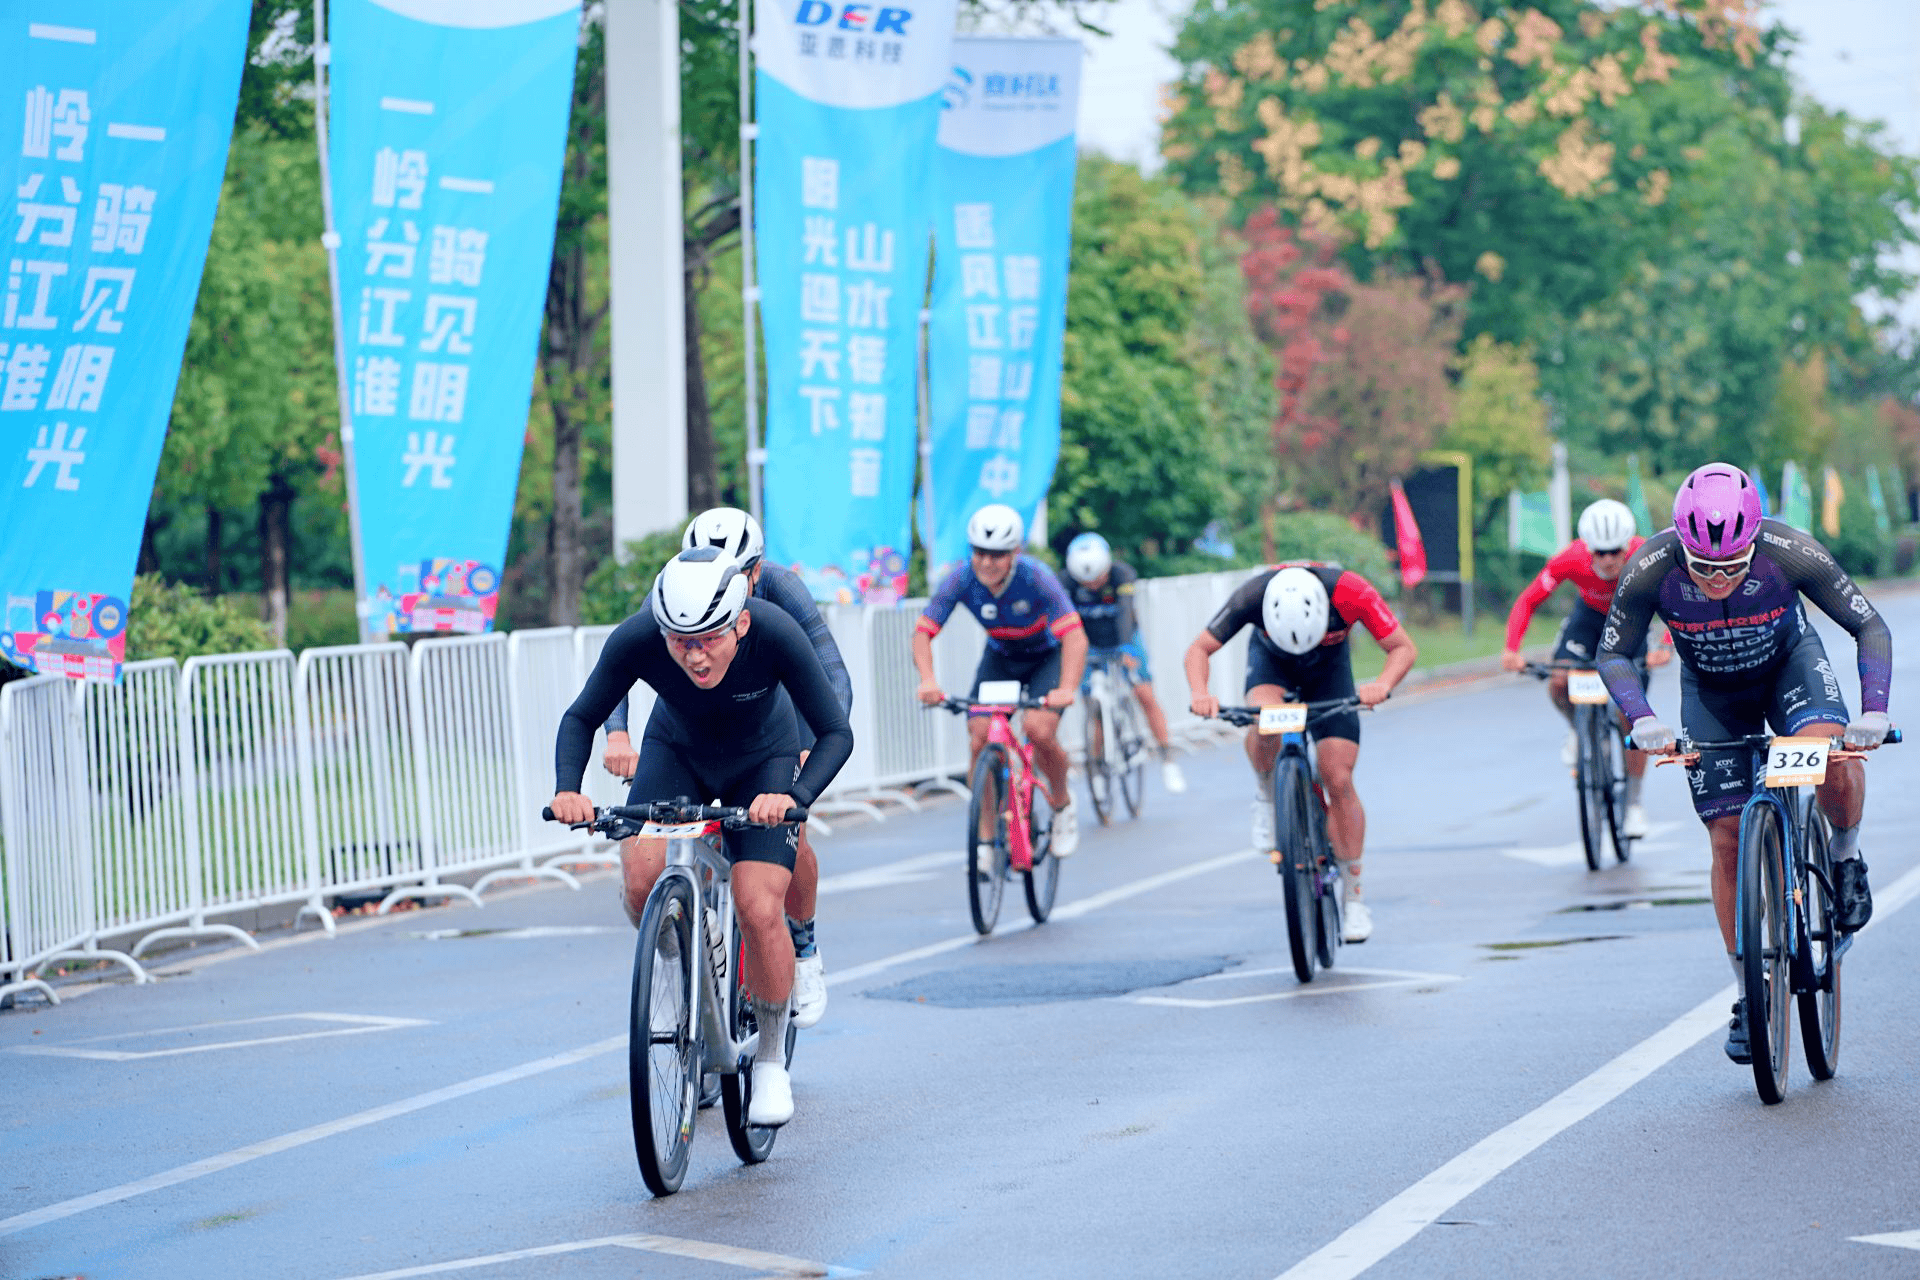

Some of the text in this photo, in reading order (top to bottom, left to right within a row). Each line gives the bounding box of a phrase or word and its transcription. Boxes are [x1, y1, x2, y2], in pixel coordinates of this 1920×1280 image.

[795, 0, 912, 35] DER
[23, 122, 166, 490] 一骑见明光
[354, 96, 435, 417] 一岭分江淮
[401, 176, 495, 489] 一骑见明光
[1773, 751, 1820, 769] 326
